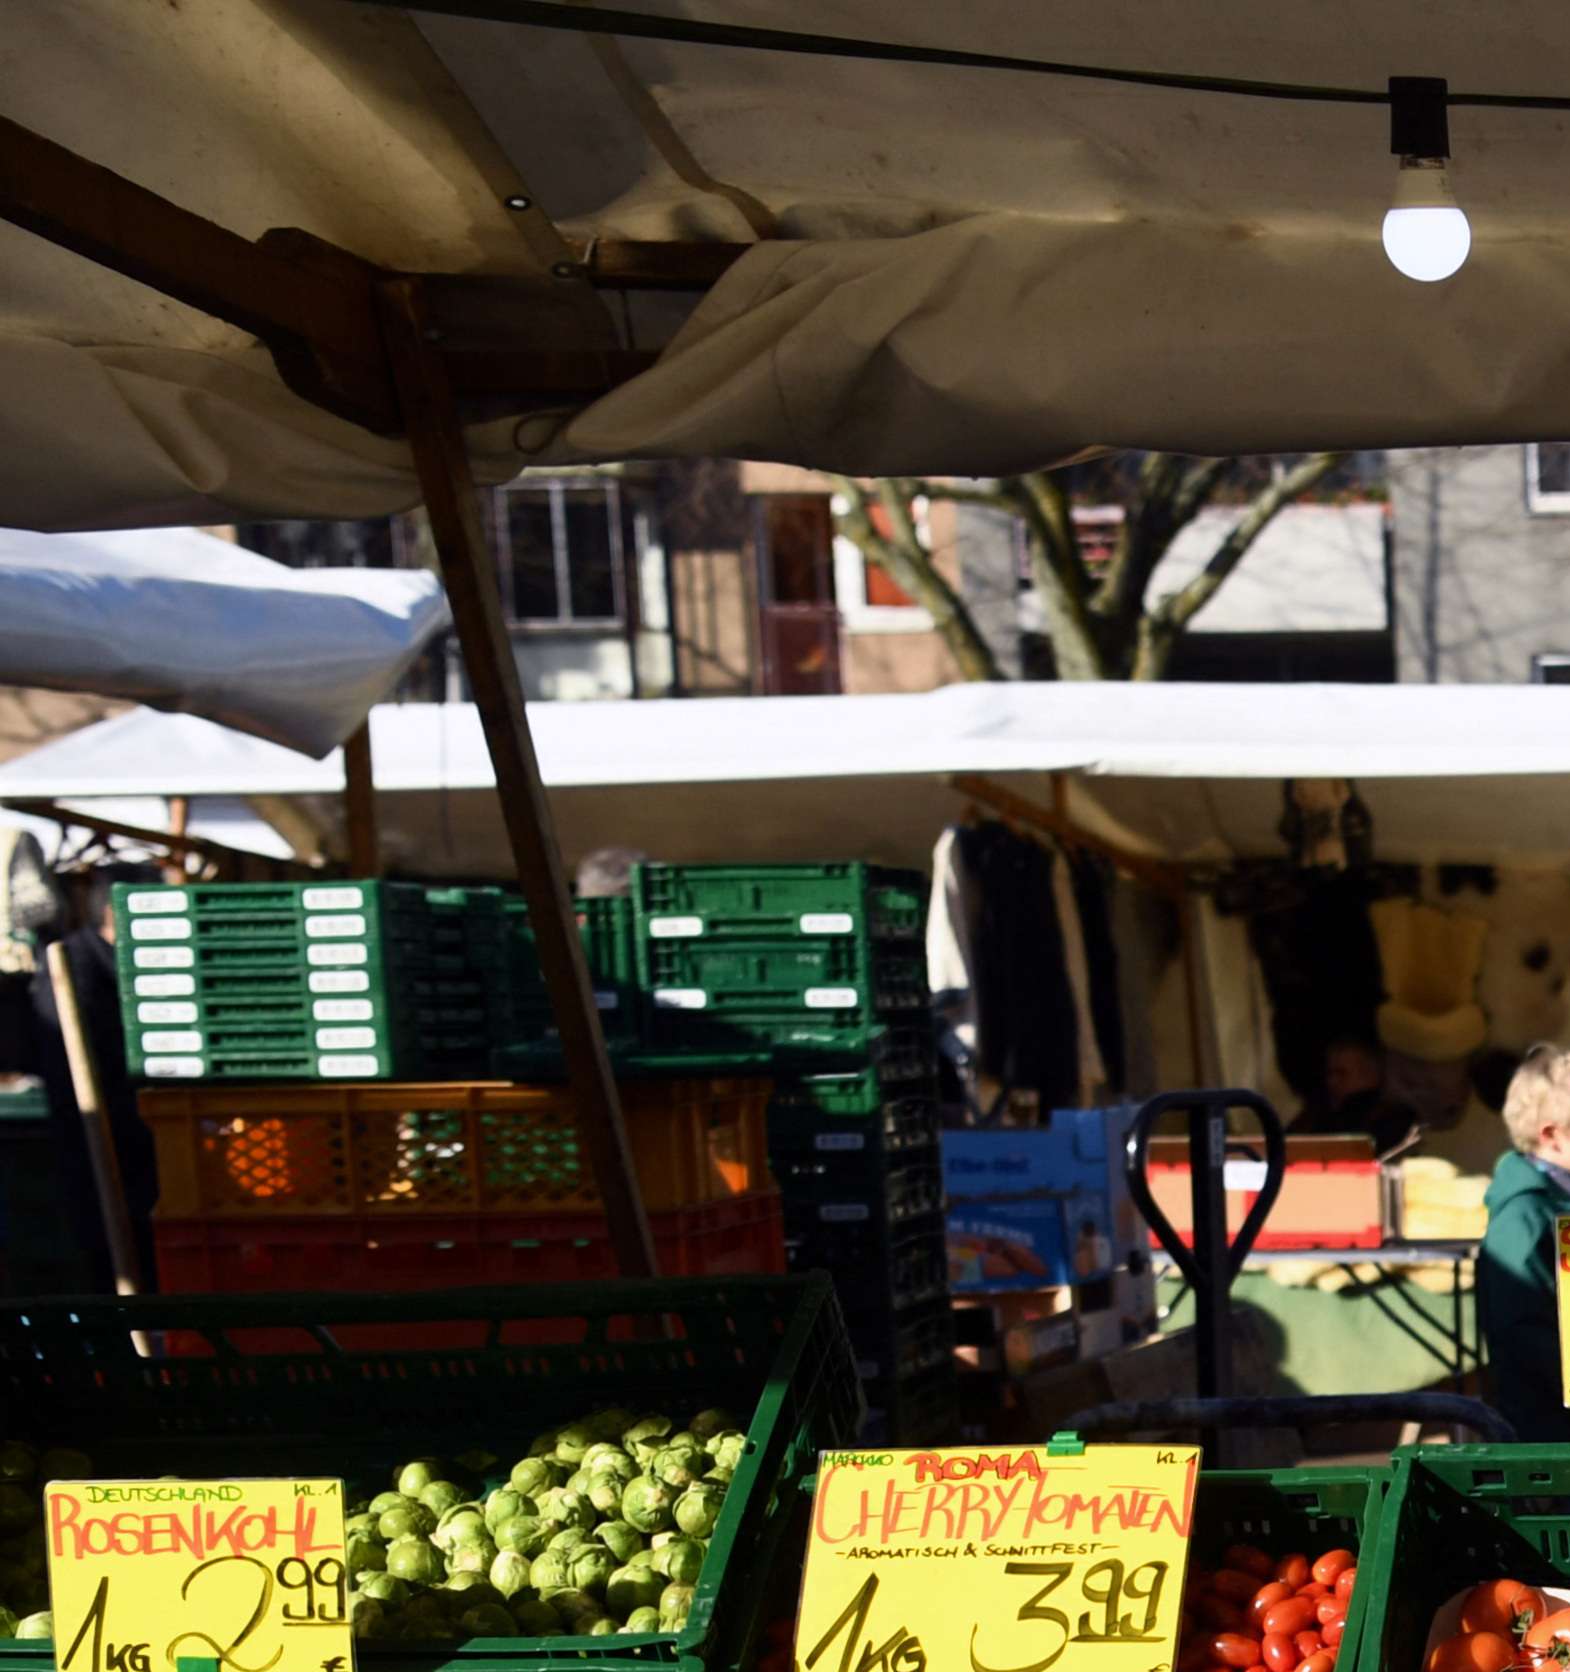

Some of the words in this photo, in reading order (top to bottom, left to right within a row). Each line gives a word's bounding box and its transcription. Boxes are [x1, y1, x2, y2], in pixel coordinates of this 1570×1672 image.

[904, 1450, 1043, 1483] ROMA
[86, 1485, 243, 1503] DEUTSCHLAND
[50, 1494, 342, 1560] ROSENKOHL
